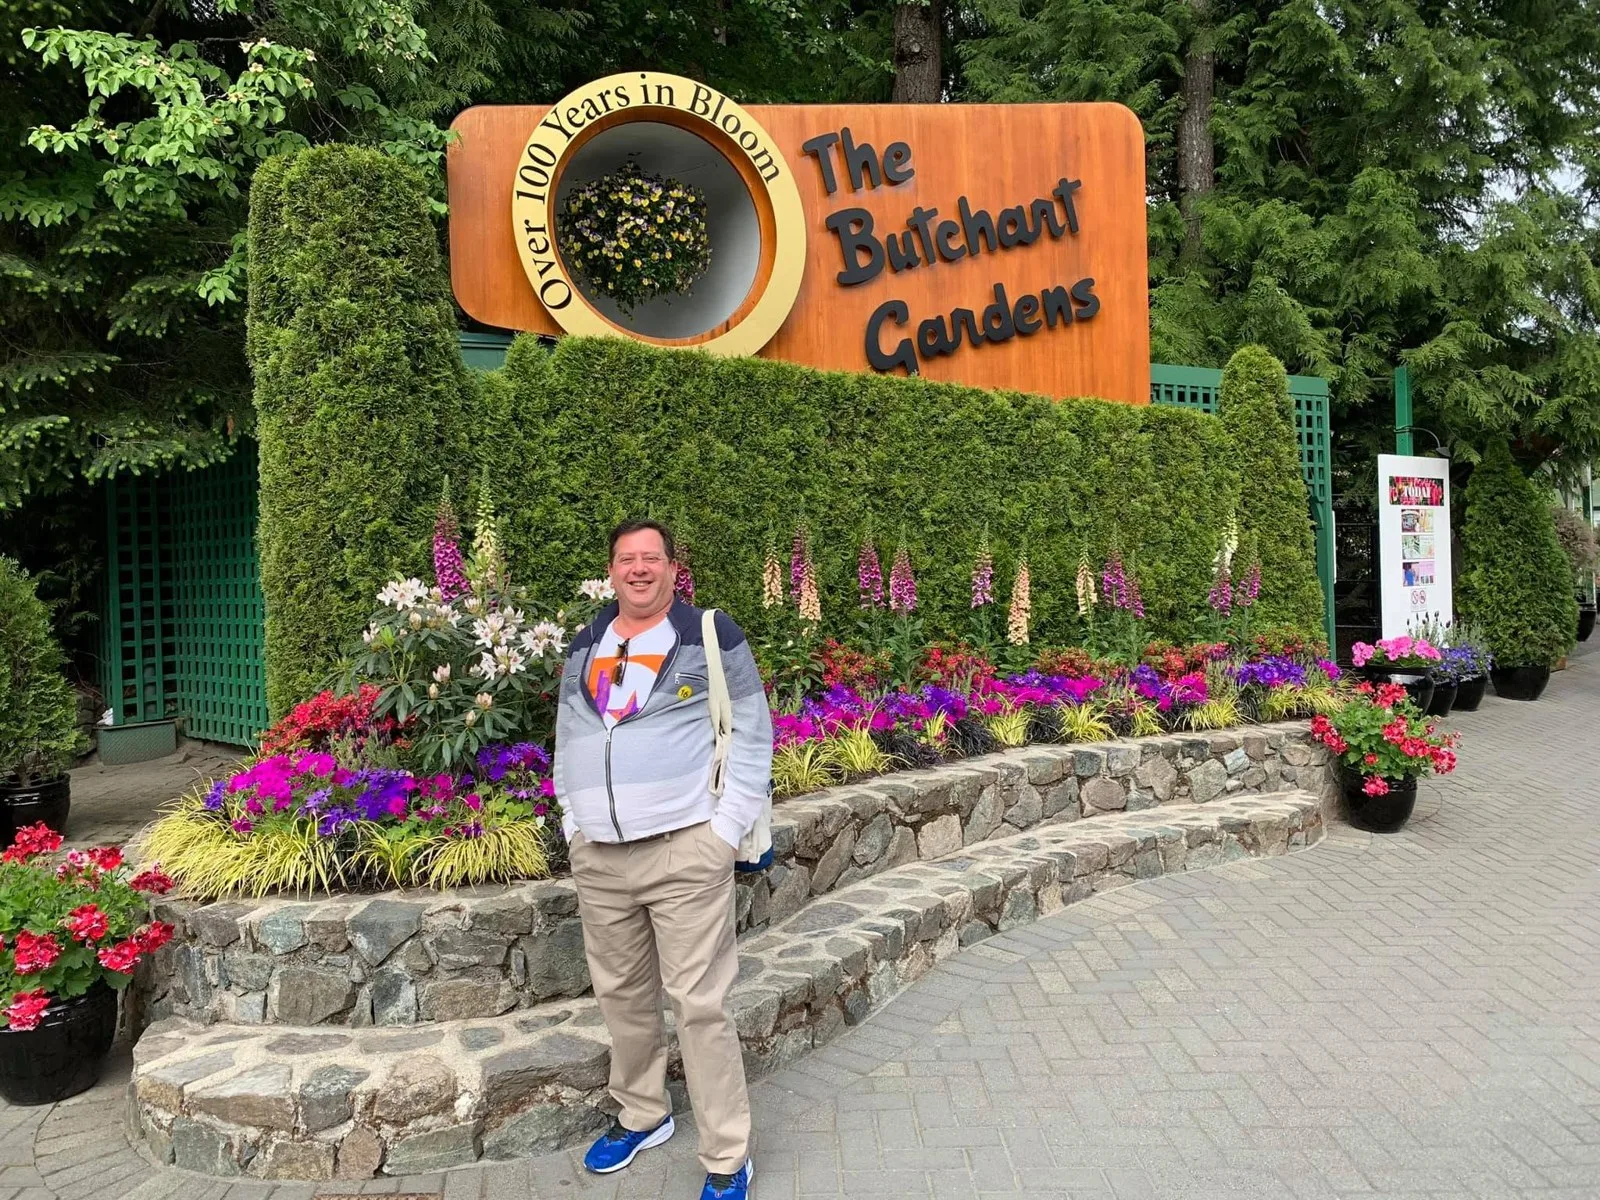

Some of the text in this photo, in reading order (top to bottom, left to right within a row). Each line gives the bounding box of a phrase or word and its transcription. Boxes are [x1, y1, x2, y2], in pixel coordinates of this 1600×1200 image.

[516, 73, 781, 310] Over 100 Years in Bloom
[802, 127, 915, 194] The
[825, 177, 1082, 285] Butchart
[865, 277, 1101, 376] Gardens
[680, 689, 689, 698] 16
